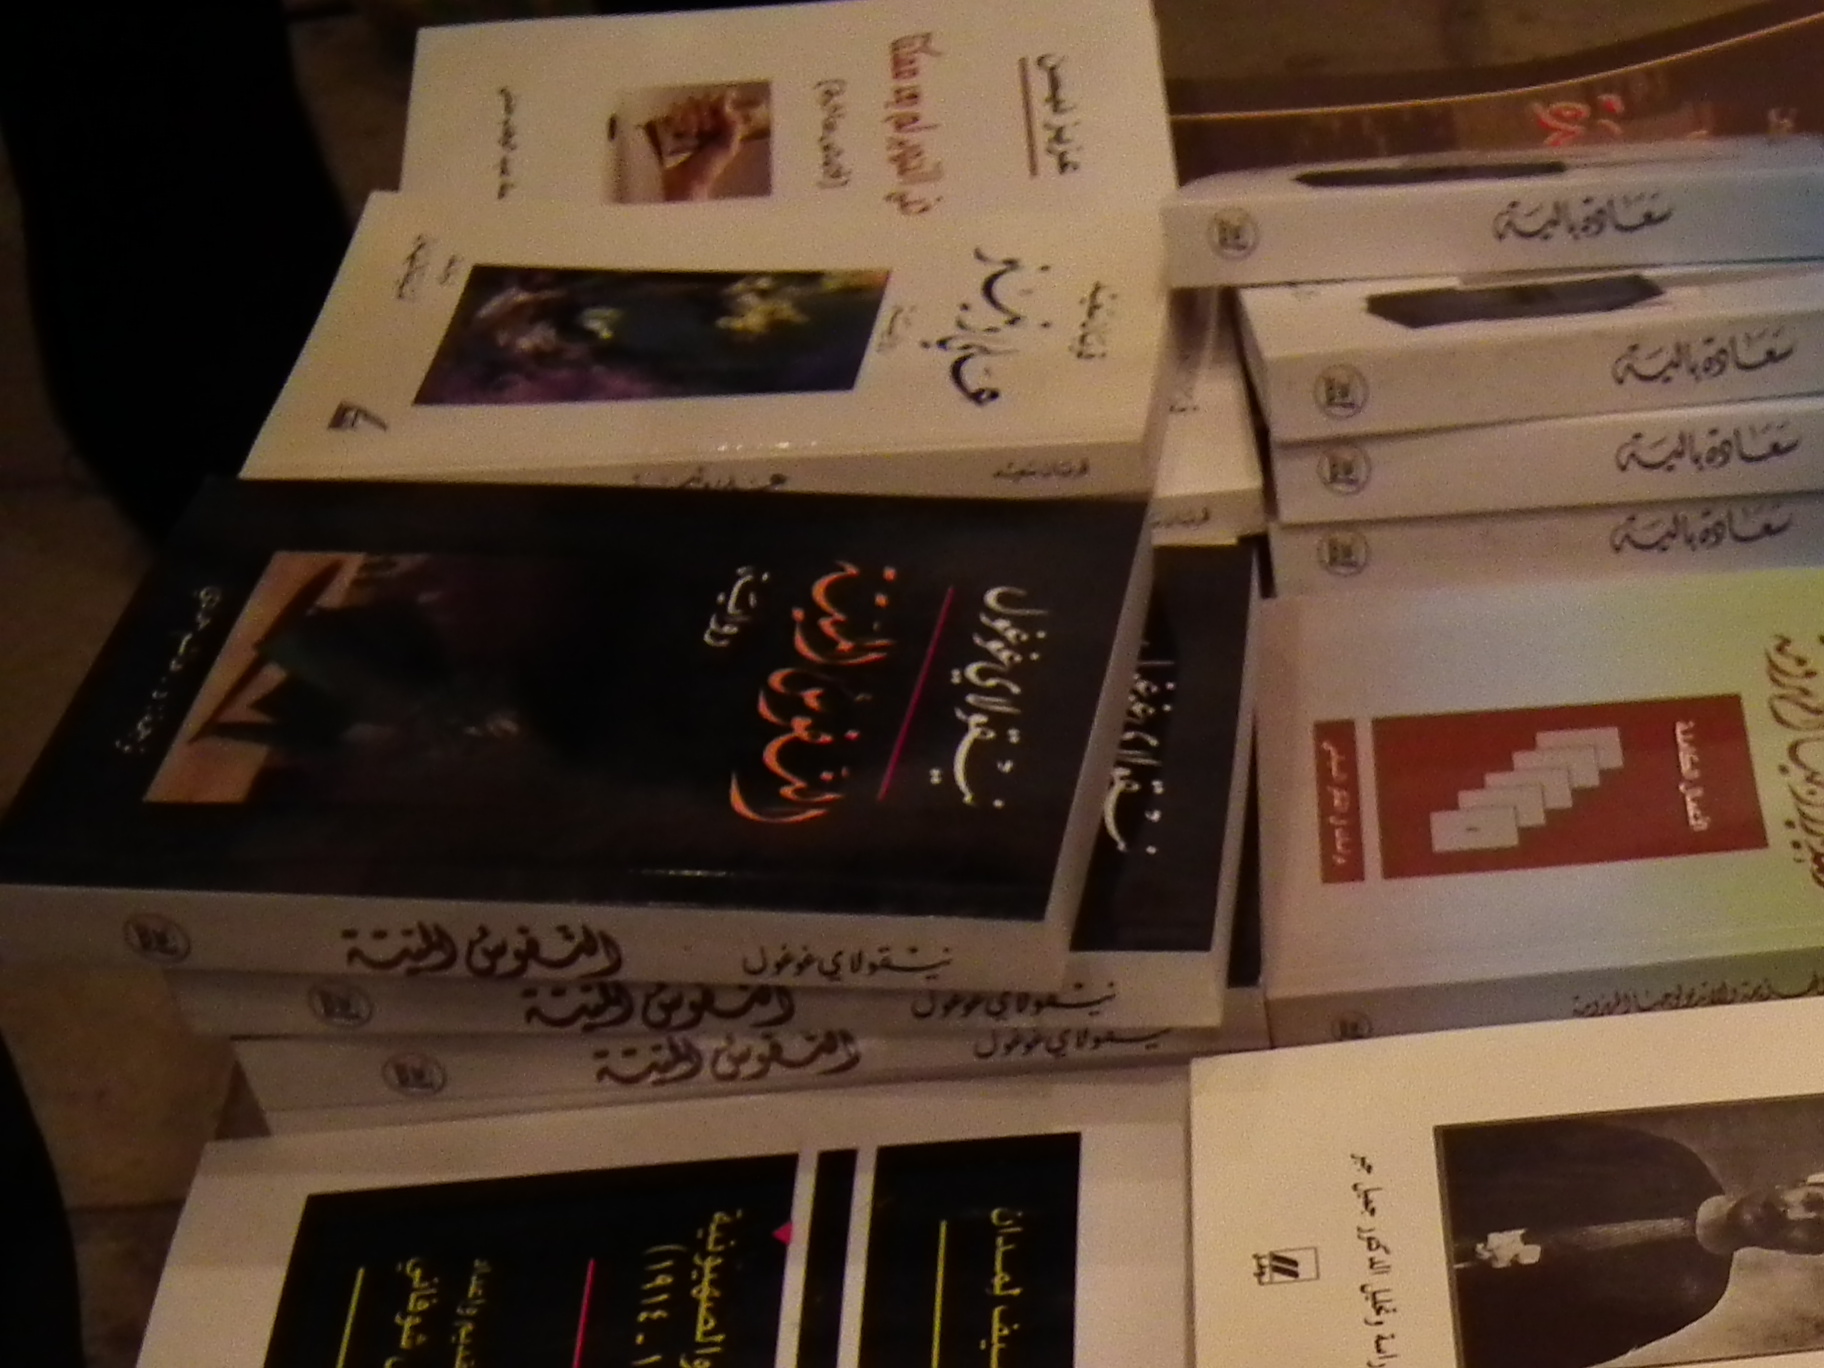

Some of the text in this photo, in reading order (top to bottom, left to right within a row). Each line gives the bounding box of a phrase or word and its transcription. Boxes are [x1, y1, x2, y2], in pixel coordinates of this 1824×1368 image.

[1492, 190, 1675, 242] سعادة بالية
[1612, 325, 1795, 388] سعادة بالية
[1616, 420, 1800, 474] سعادة بالية
[1610, 502, 1793, 554] سعادة بالية
[702, 564, 771, 648] رواية
[729, 559, 898, 824] النفوس الميتة
[928, 586, 1049, 809] نيقولاي غوغول
[341, 921, 623, 979] النفوس الميتة
[741, 942, 953, 984] نيقولاي غوغول
[522, 982, 795, 1031] النفوس الميتة
[591, 1029, 863, 1084] النفوس الميتة
[1351, 1181, 1384, 1218] جميل
[1356, 1225, 1392, 1275] الدكتور
[393, 1256, 440, 1349] شوفاني
[1359, 1283, 1398, 1327] وتحليل
